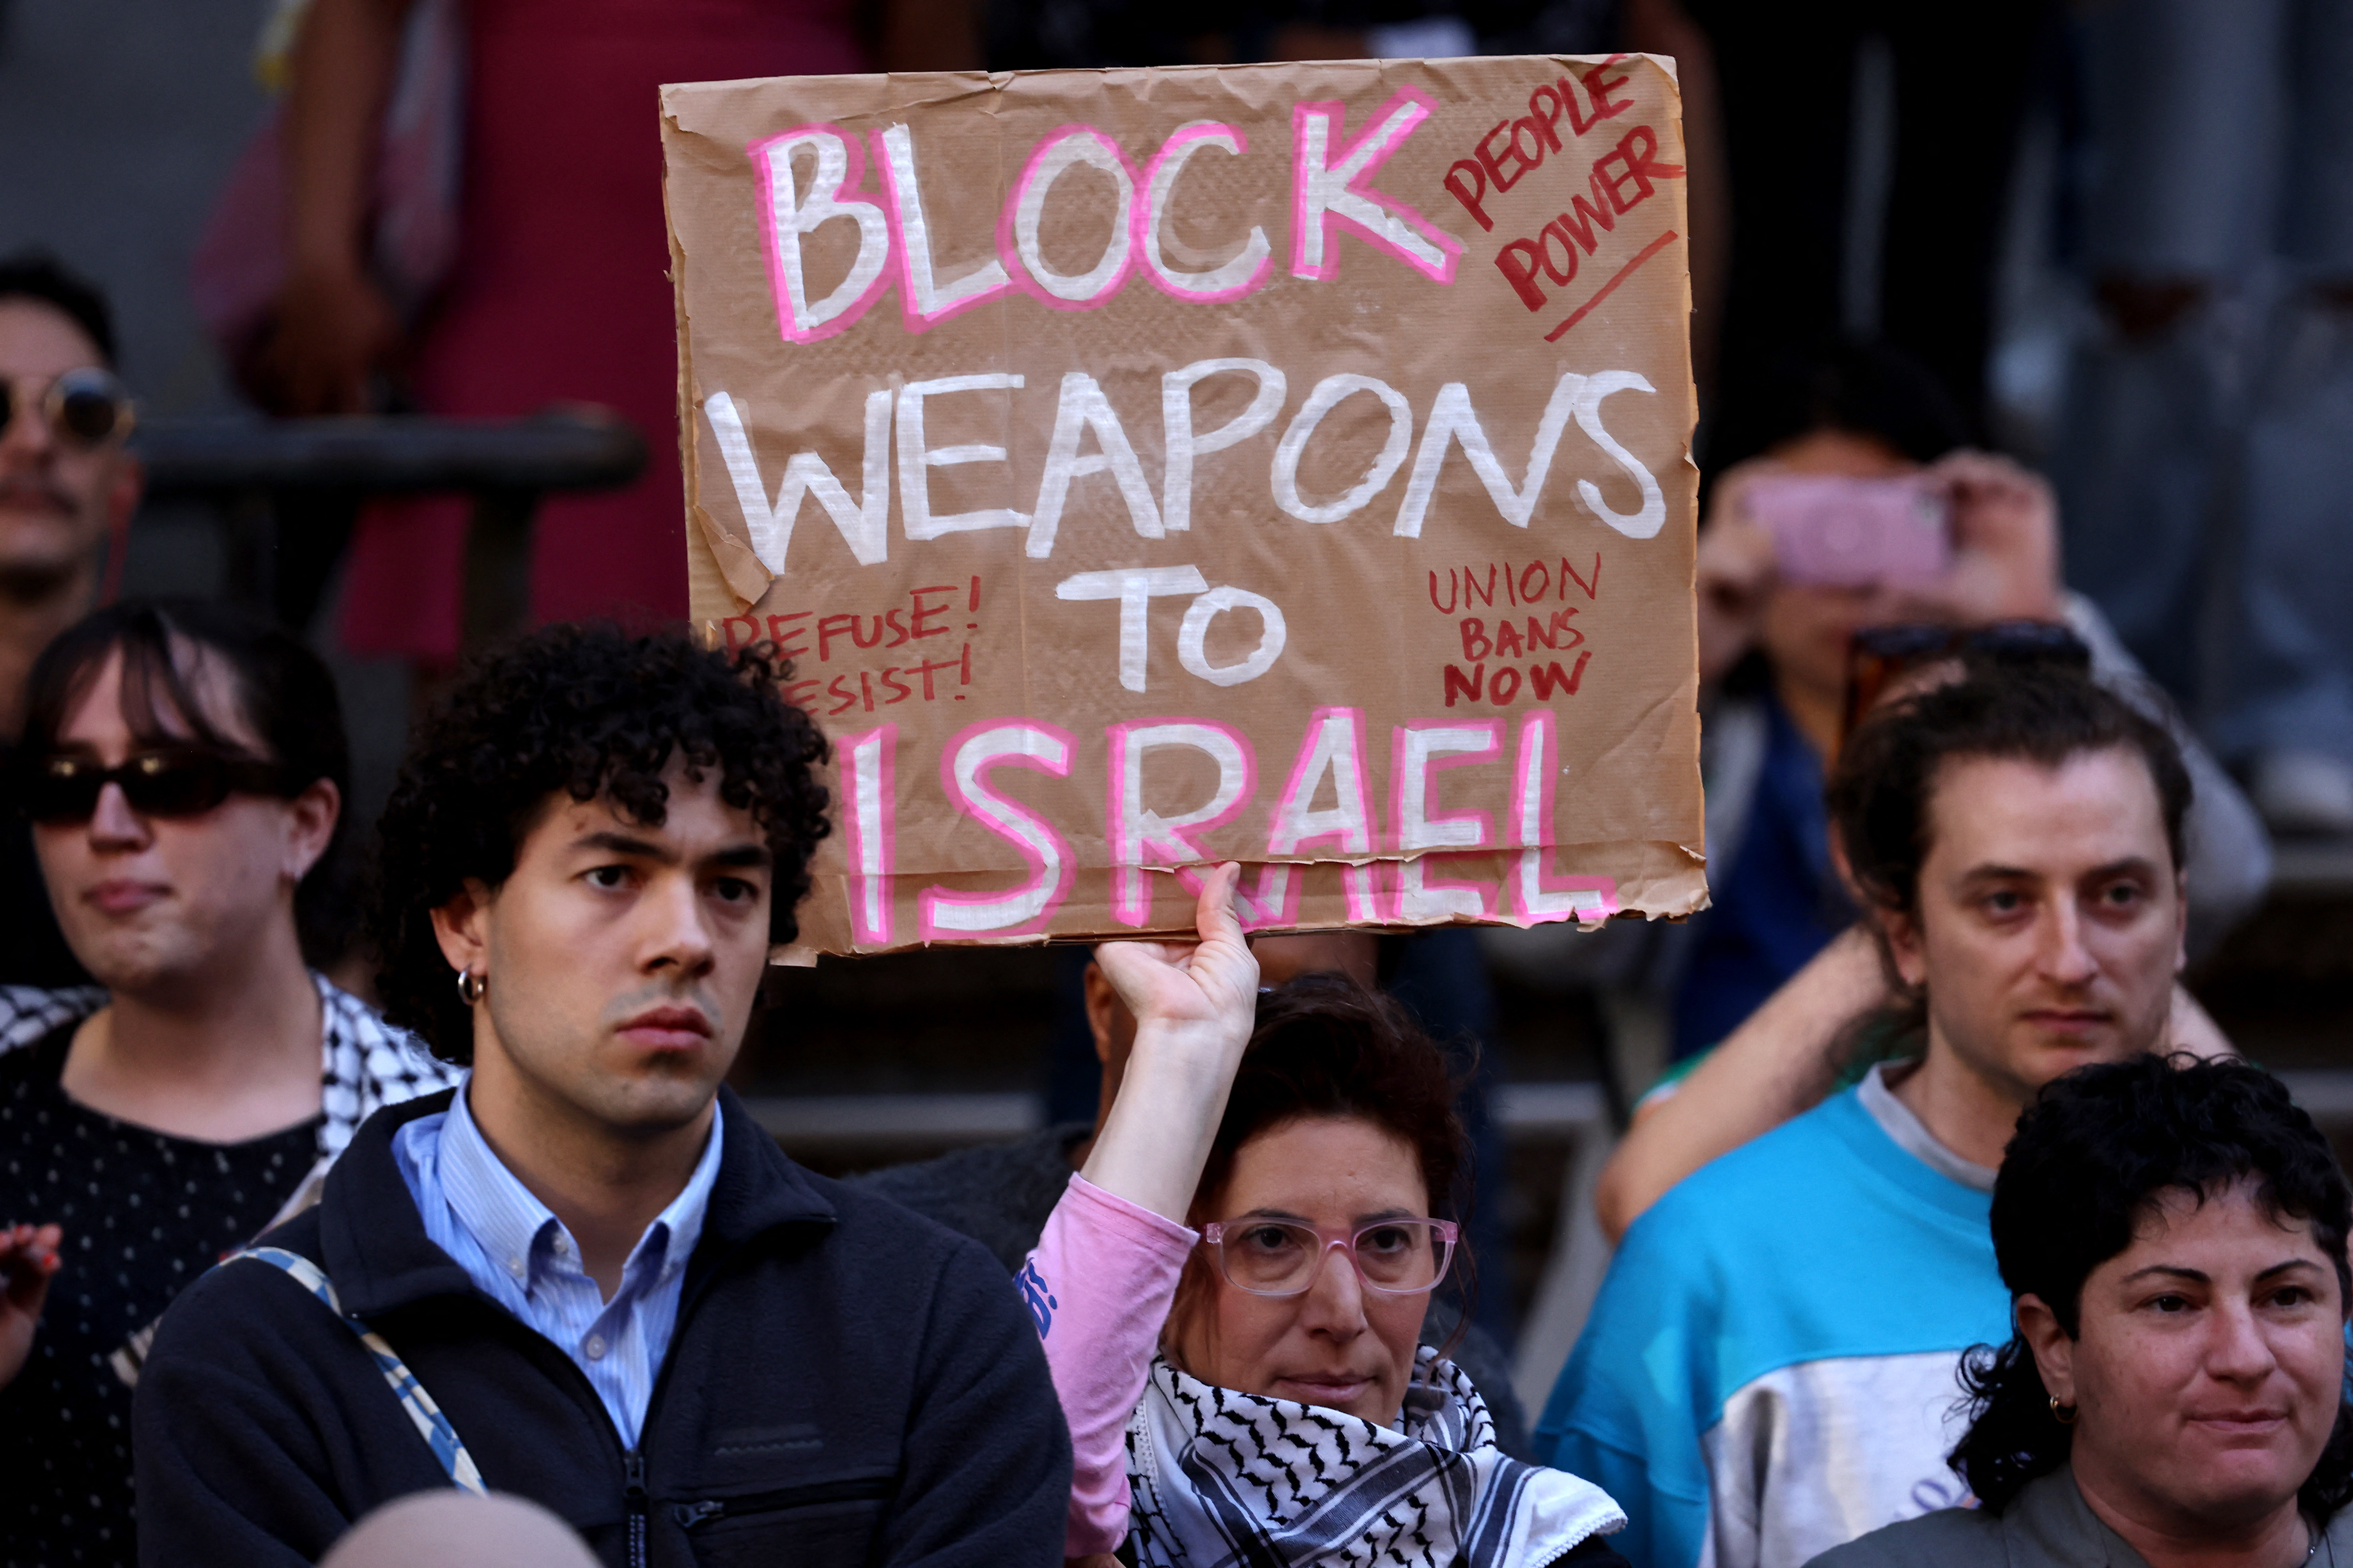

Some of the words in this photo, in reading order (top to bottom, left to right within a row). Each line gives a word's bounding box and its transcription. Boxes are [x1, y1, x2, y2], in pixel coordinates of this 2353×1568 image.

[747, 84, 1463, 343] BLOCK
[1443, 53, 1635, 233] PEOPLE
[1494, 125, 1686, 312] POWER
[705, 358, 1665, 575] WEAPONS
[1055, 565, 1286, 692] TO
[1429, 552, 1601, 615] UNION
[1460, 607, 1585, 662] BANS
[779, 642, 971, 716] ESIST!
[1444, 650, 1592, 707] NOW
[838, 706, 1618, 944] ISRAEL
